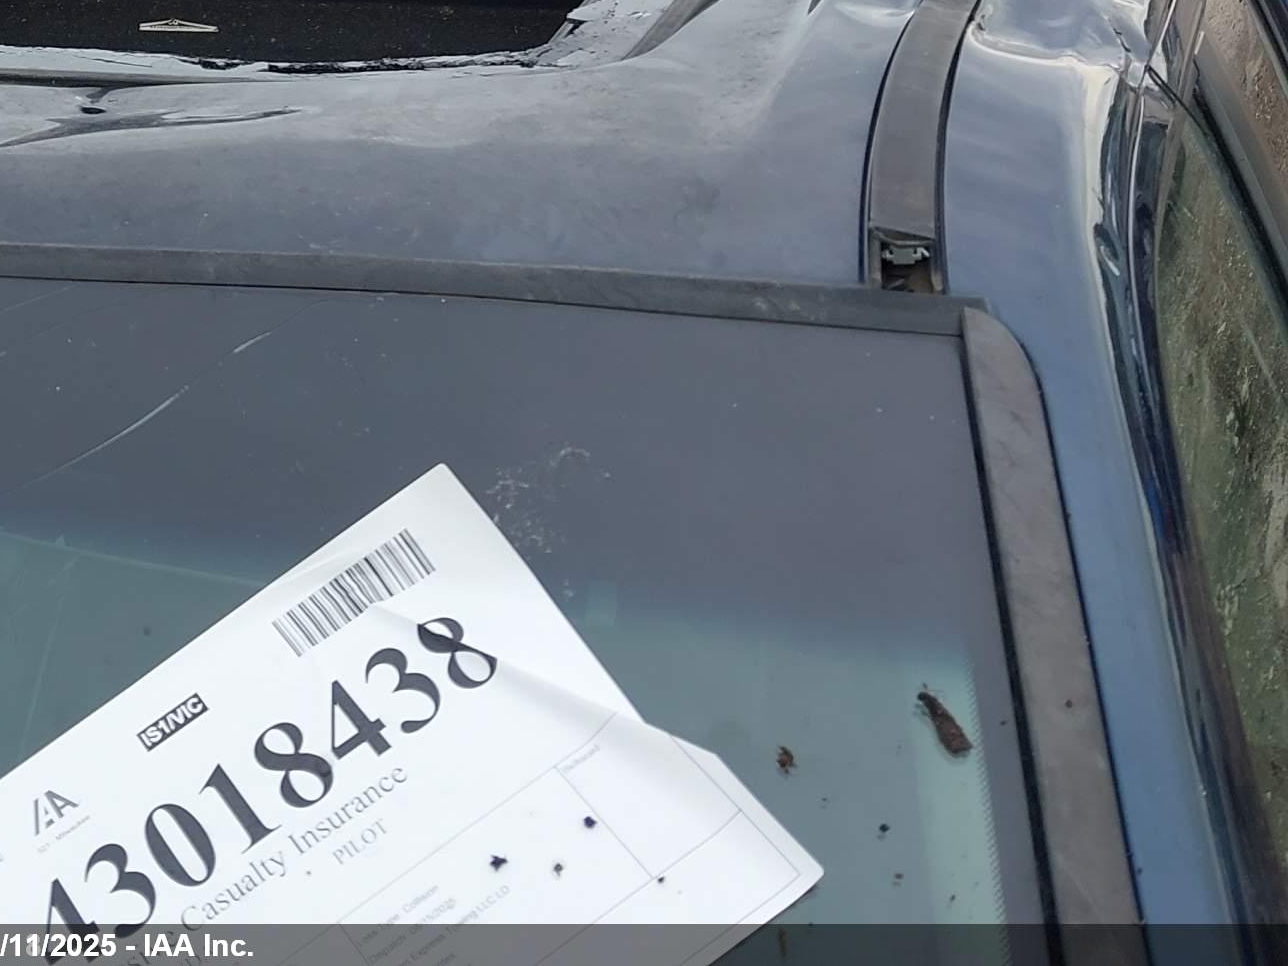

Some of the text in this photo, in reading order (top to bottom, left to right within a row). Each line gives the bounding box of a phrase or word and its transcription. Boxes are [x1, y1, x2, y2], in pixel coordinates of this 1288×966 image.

[45, 617, 497, 965] 43018438
[181, 767, 408, 932] Casualty Insurance
[332, 818, 389, 865] PILOT
